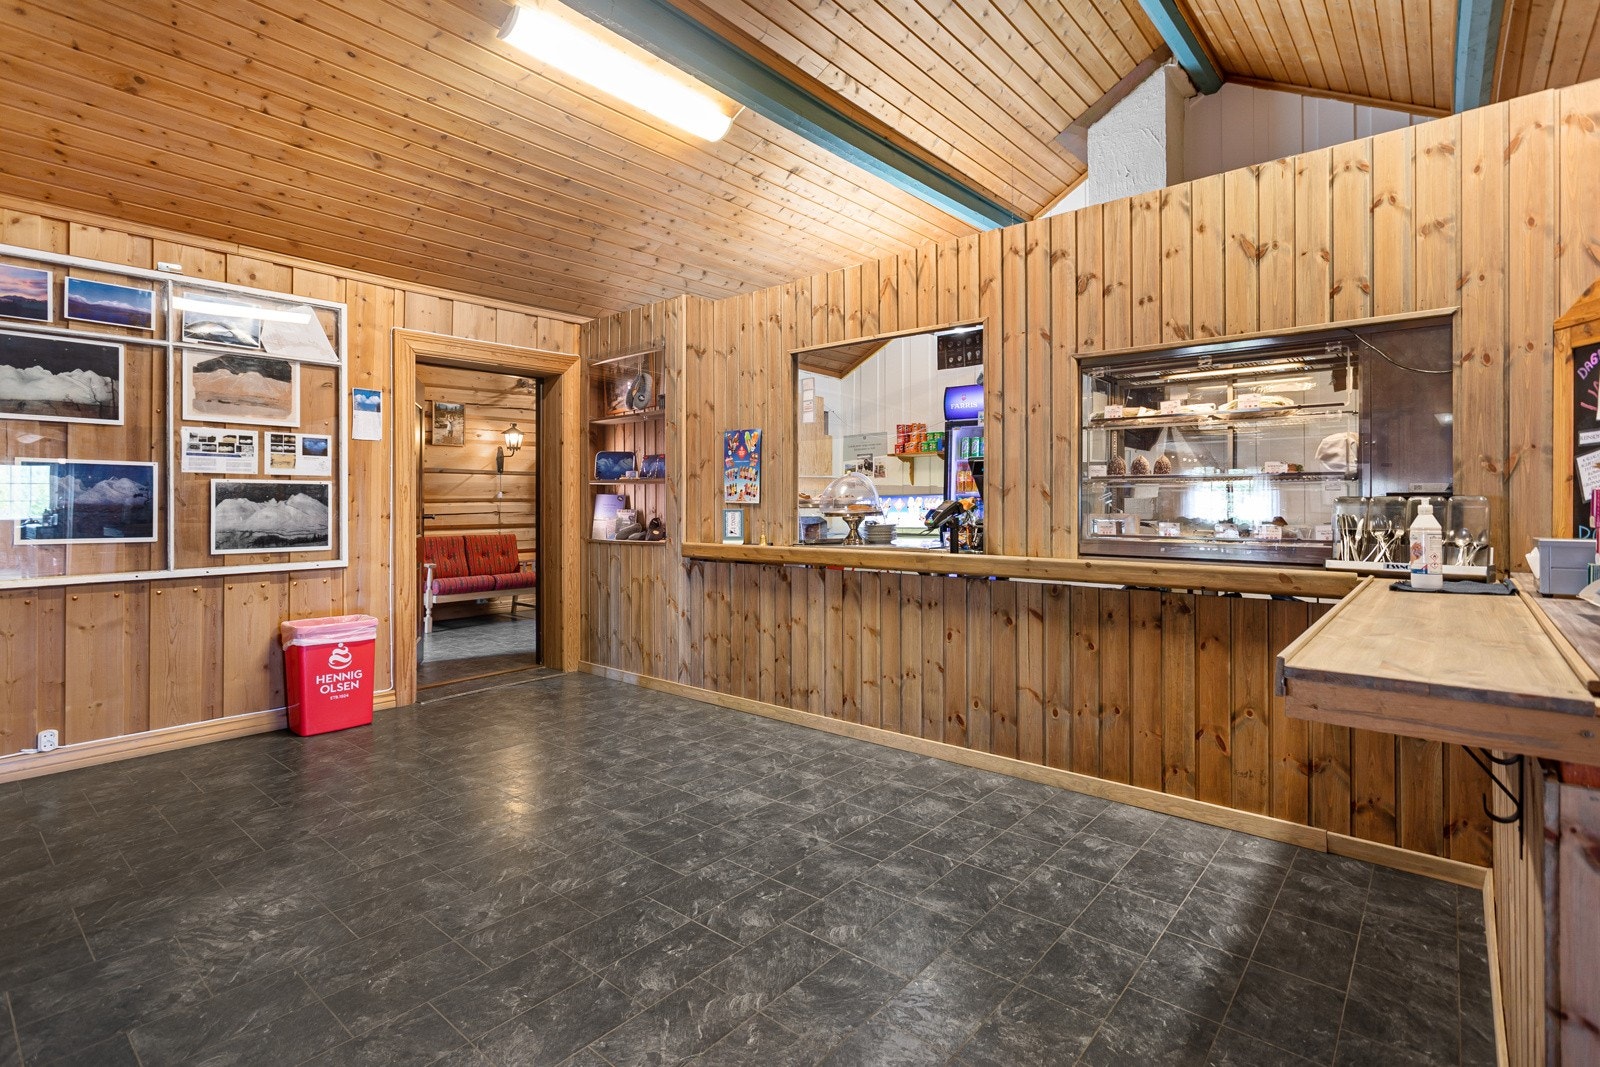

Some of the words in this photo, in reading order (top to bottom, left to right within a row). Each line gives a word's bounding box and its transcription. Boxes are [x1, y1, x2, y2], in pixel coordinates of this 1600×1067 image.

[950, 402, 978, 410] FARRIS
[315, 670, 363, 684] HENNIG
[320, 680, 360, 694] OLSEN
